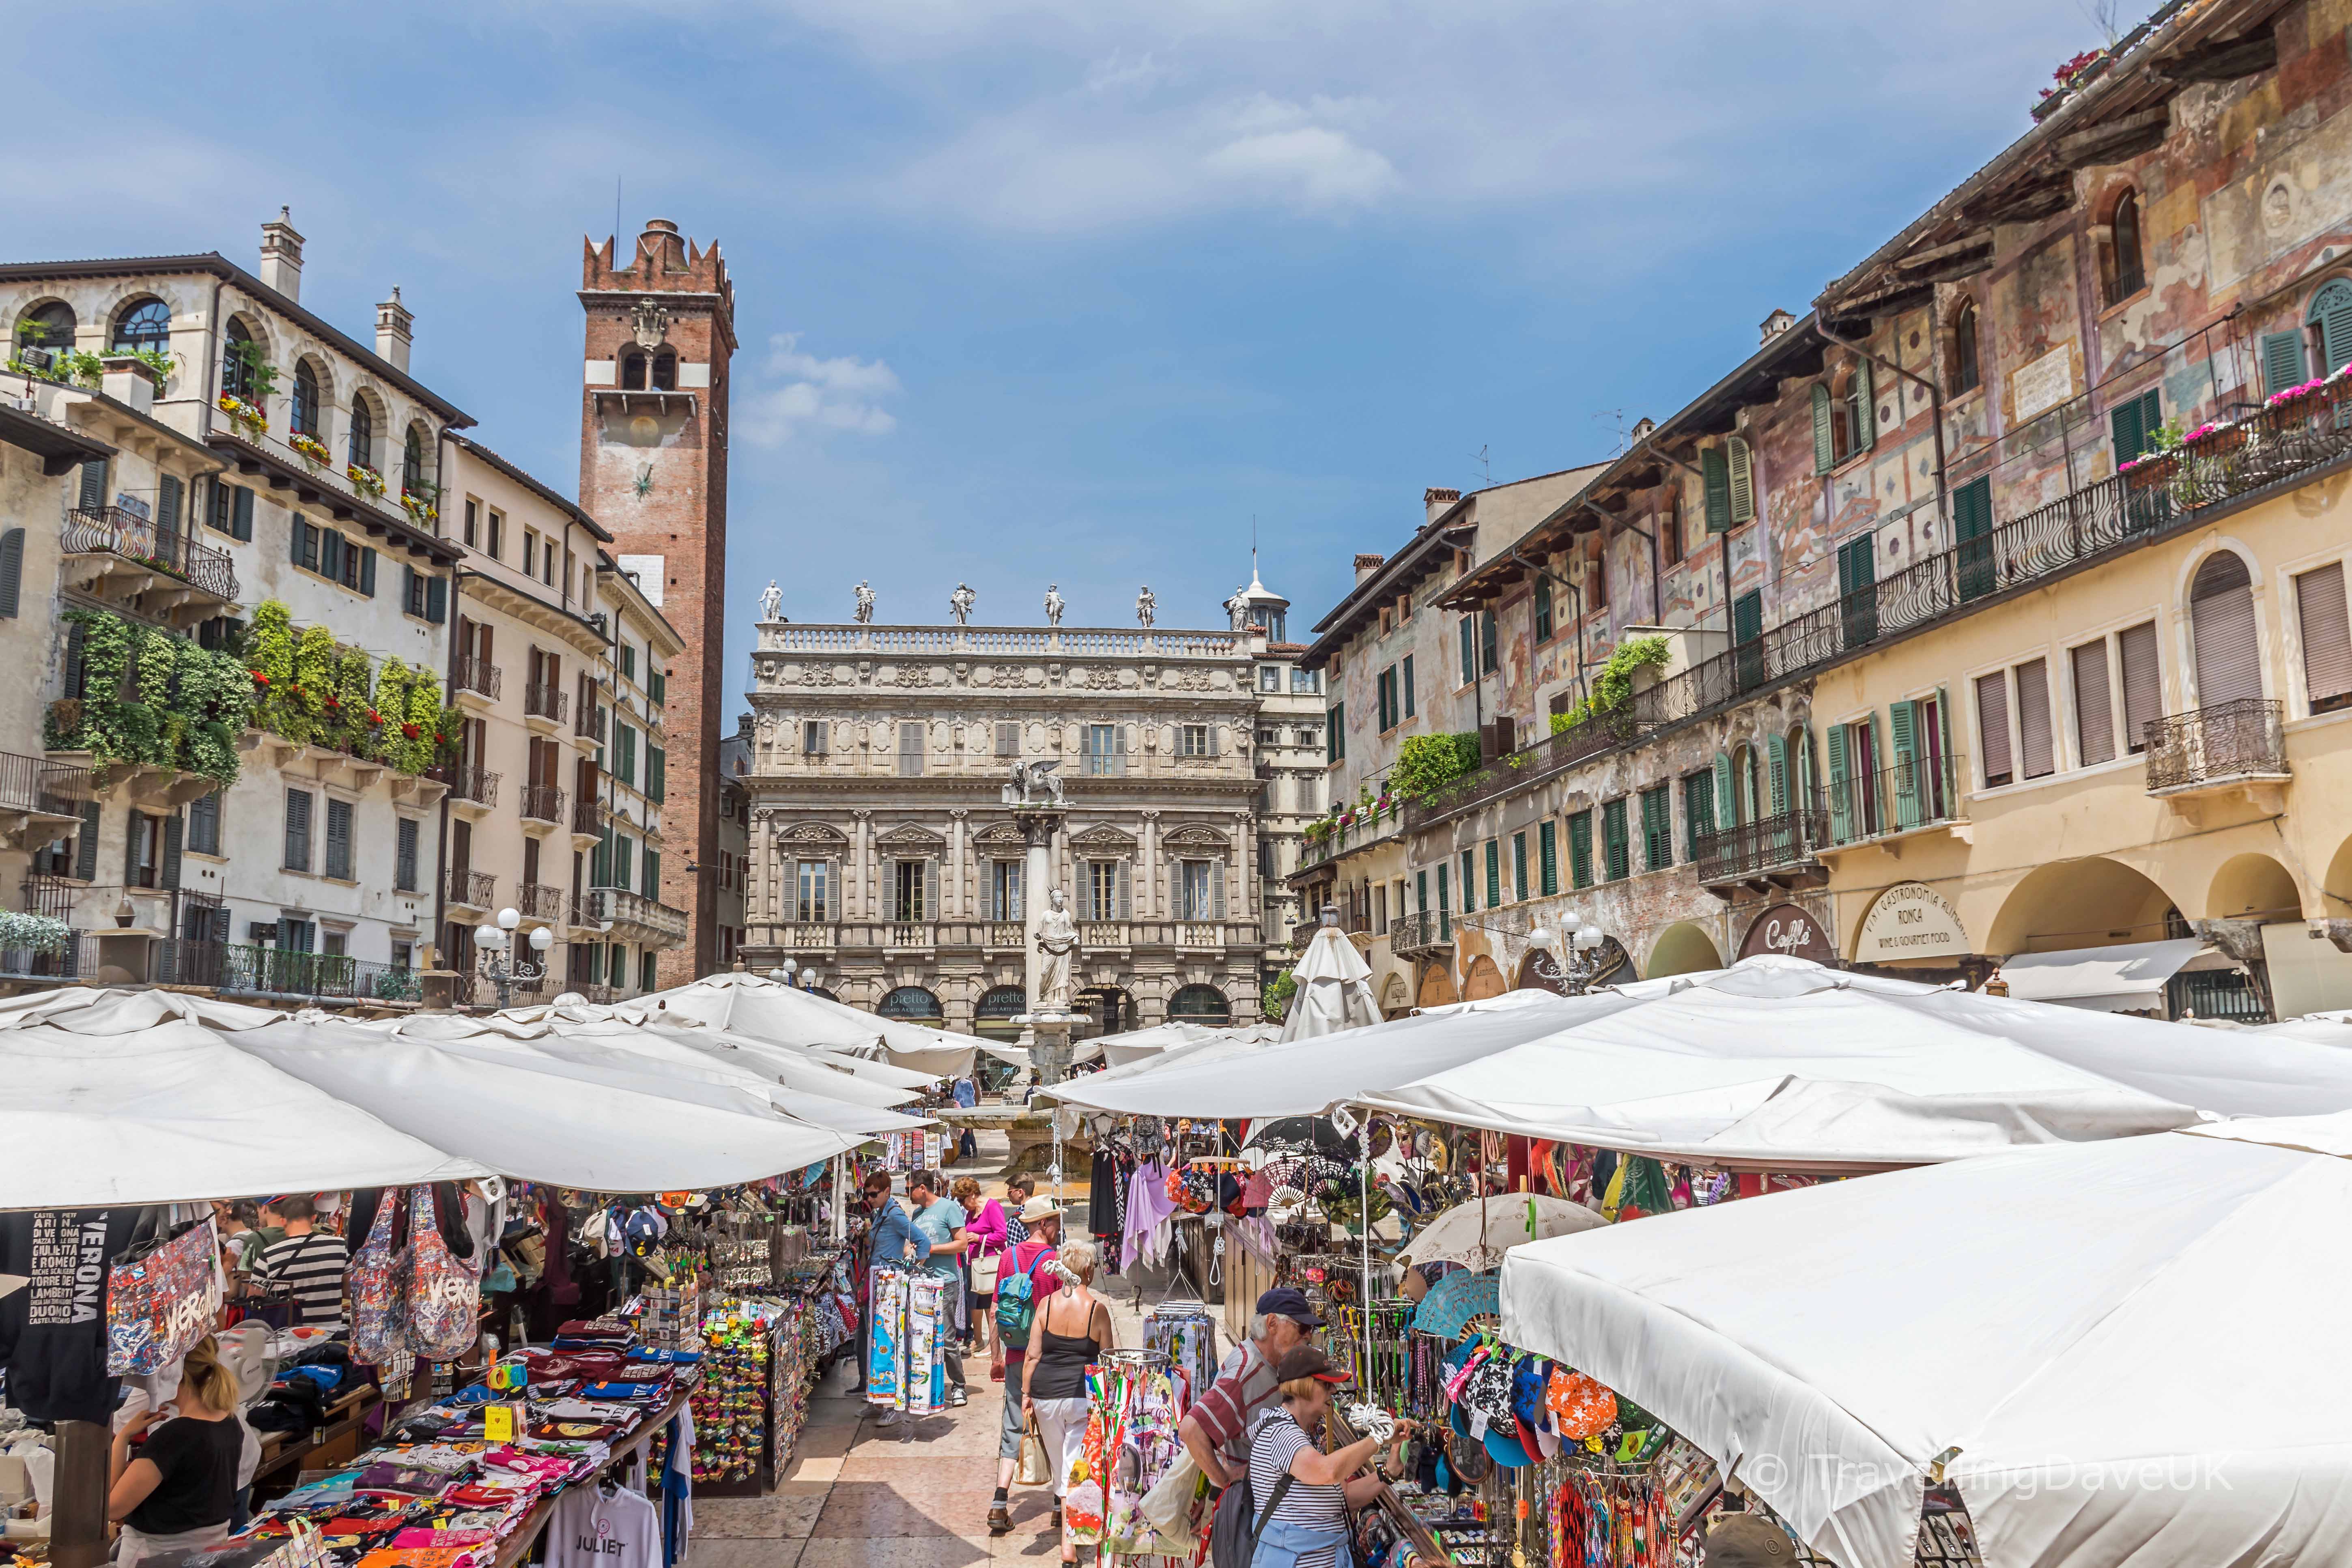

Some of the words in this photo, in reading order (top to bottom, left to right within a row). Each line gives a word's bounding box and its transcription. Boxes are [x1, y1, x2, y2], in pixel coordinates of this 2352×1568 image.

[1866, 908, 1880, 933] VINI
[1881, 887, 1939, 910] GASTRONOMIA
[1898, 908, 1923, 925] RONCA
[1765, 918, 1812, 956] Caffè
[1879, 938, 1894, 949] WINE
[1894, 937, 1899, 947] &
[1900, 933, 1929, 946] GOURMET
[1930, 932, 1950, 944] FOOD
[891, 992, 928, 1007] pretto
[988, 992, 1025, 1006] pretto
[34, 1229, 41, 1238] DI
[44, 1228, 80, 1237] VEONA
[32, 1257, 37, 1269] E
[41, 1256, 76, 1268] ROMEO
[71, 1211, 108, 1323] VERONA
[32, 1275, 60, 1286] TORRE
[31, 1287, 73, 1298] LAMBERTI
[30, 1305, 71, 1317] DUOMO
[576, 1535, 626, 1557] JULIET
